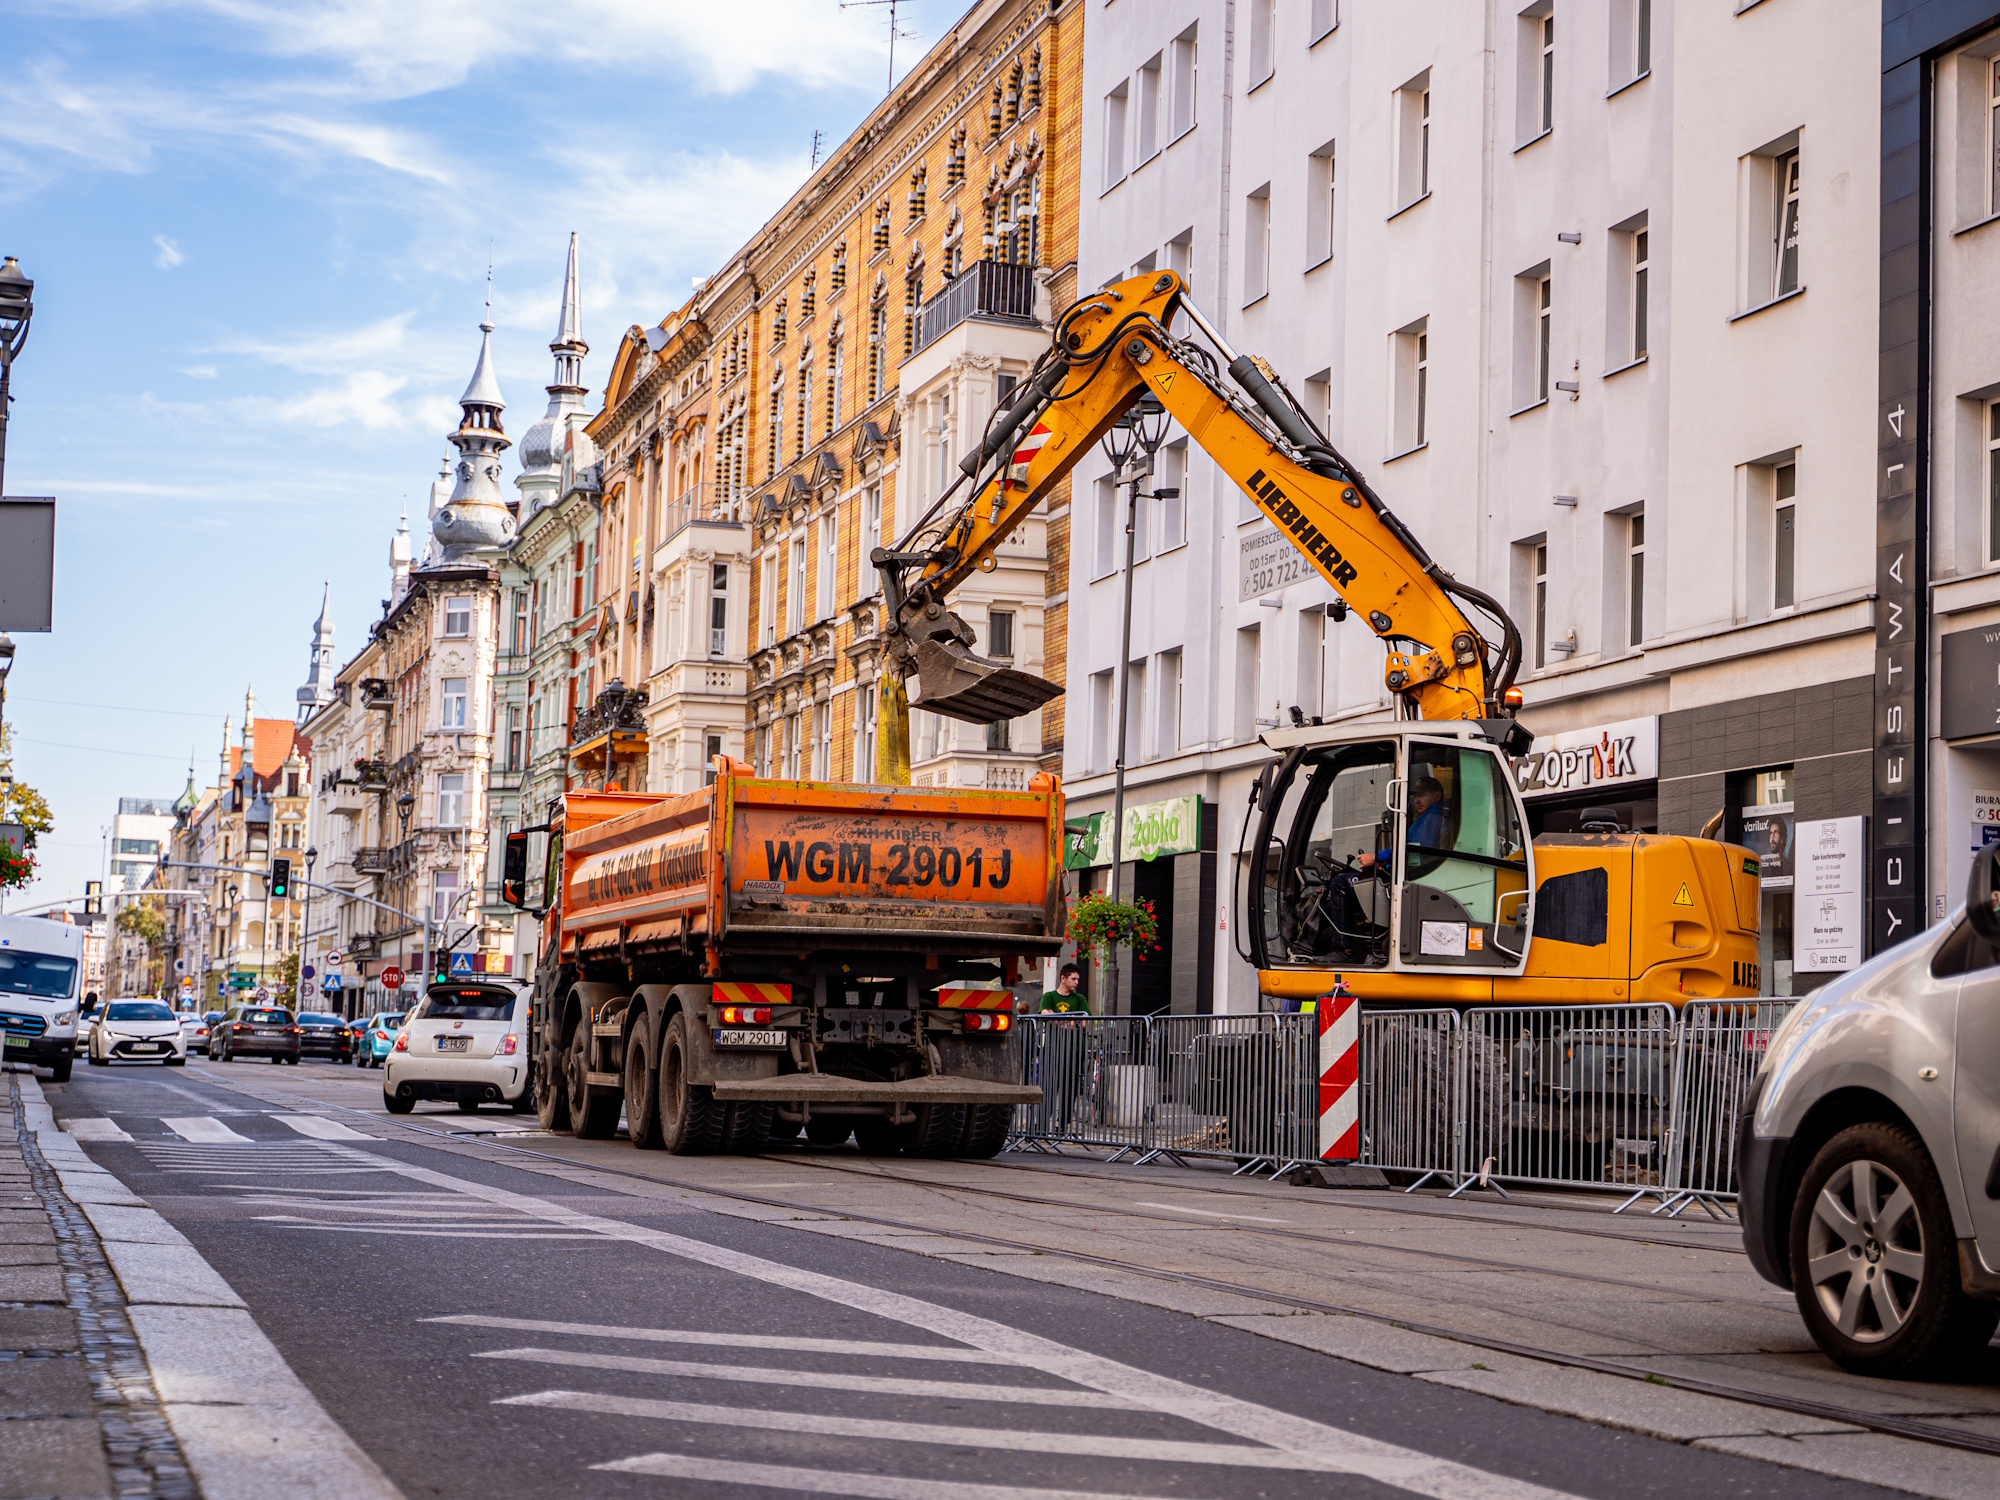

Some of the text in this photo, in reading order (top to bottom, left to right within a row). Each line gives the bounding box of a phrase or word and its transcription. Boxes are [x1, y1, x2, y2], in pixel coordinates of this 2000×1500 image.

[1245, 468, 1357, 589] LIEBHERR
[1249, 559, 1259, 571] OD
[1280, 546, 1290, 560] DO
[1253, 568, 1273, 593] 502
[1277, 559, 1298, 585] 722
[1133, 811, 1178, 847] żabka
[659, 834, 705, 888] Transport
[765, 840, 1011, 889] WGM 2901J
[746, 881, 781, 890] HARDOX
[383, 973, 403, 982] STO
[1733, 961, 1761, 991] LIEB
[443, 1039, 449, 1049] S
[722, 1032, 784, 1045] WGM 2901J
